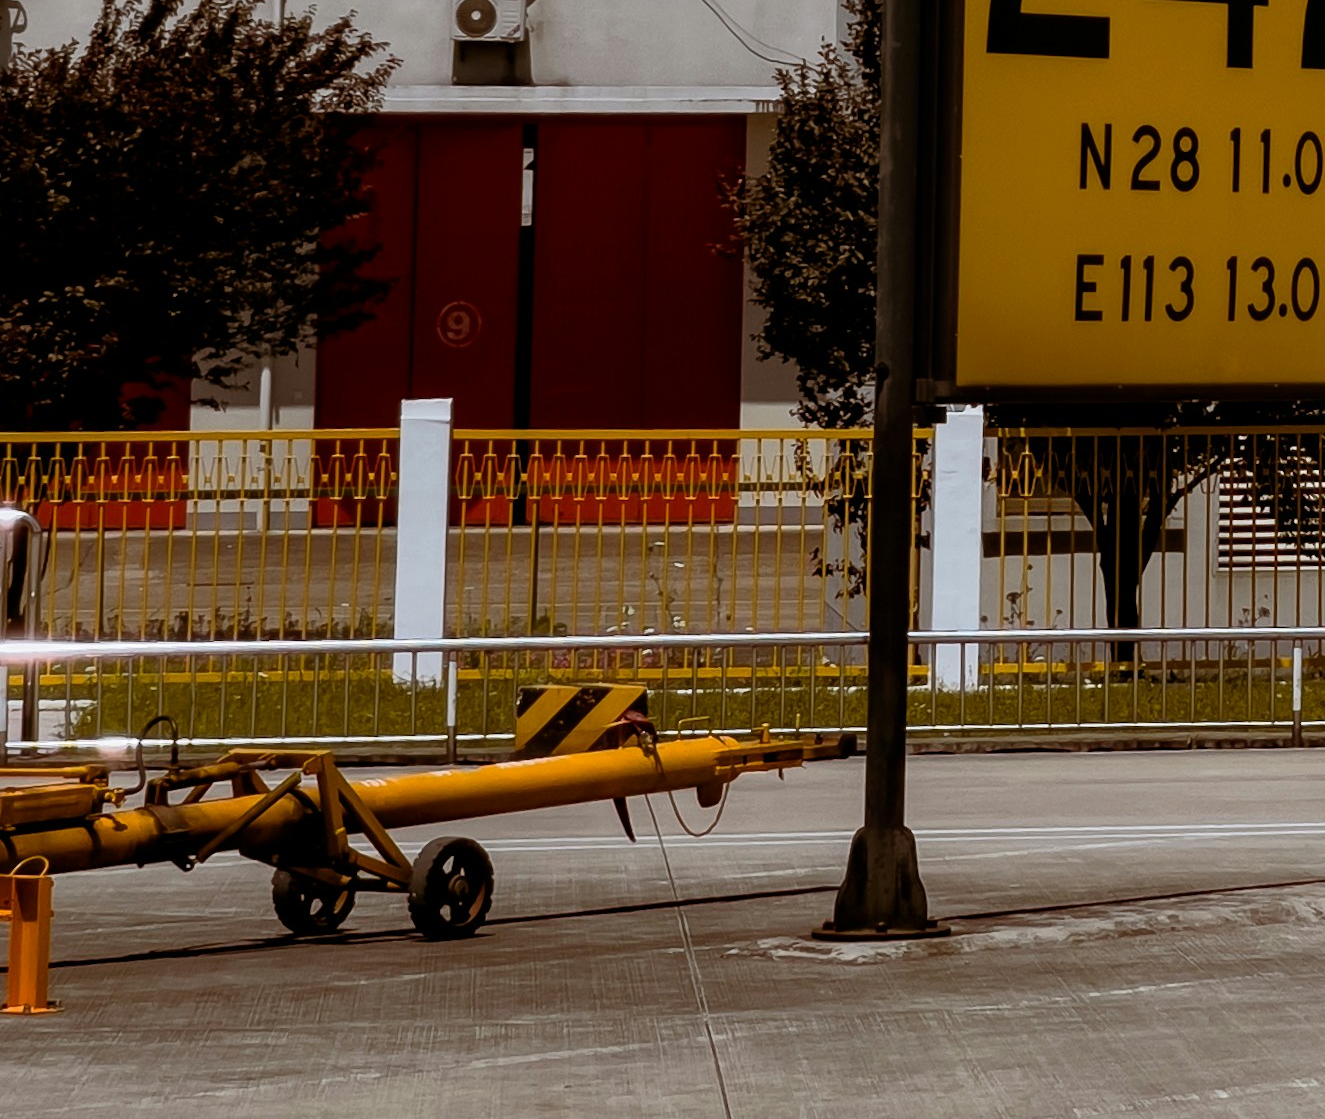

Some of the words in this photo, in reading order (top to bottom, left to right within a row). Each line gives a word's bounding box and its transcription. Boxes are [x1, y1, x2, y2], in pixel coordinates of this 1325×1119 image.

[1229, 127, 1323, 196] 11.0
[1226, 255, 1320, 322] 13.0
[446, 311, 470, 340] 9
